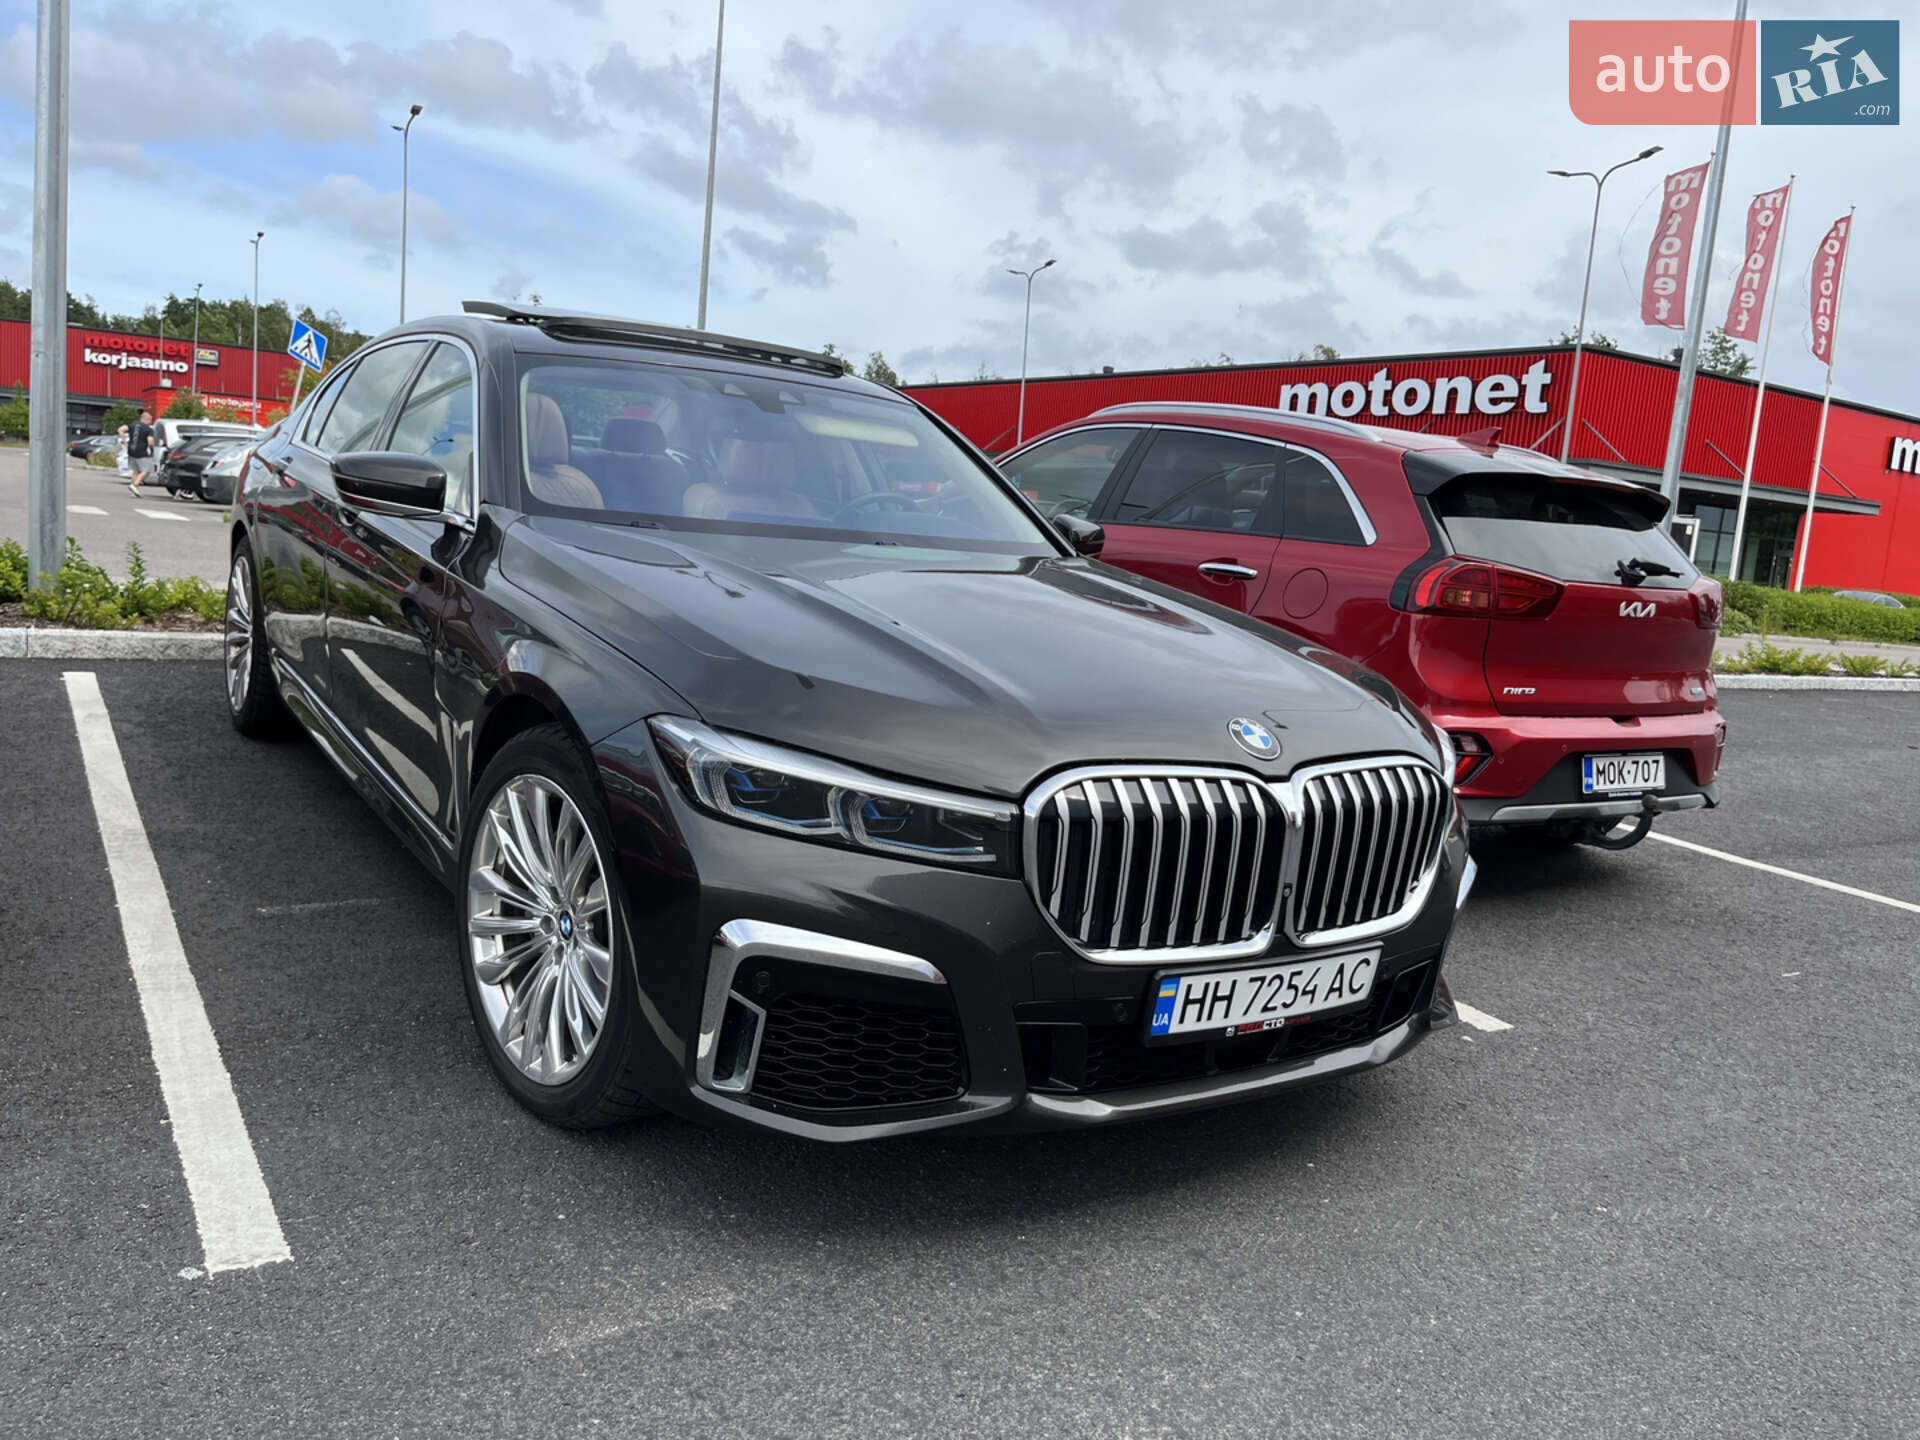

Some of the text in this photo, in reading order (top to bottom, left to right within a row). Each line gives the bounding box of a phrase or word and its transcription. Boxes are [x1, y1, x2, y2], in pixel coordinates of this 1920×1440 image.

[85, 335, 188, 356] motonet
[84, 348, 189, 373] korjaamo
[1279, 358, 1552, 417] motonet
[1619, 601, 1656, 618] KIA
[1595, 759, 1660, 786] MOK-707
[1178, 957, 1371, 1024] HH 7254 AC
[1152, 1013, 1169, 1026] UA
